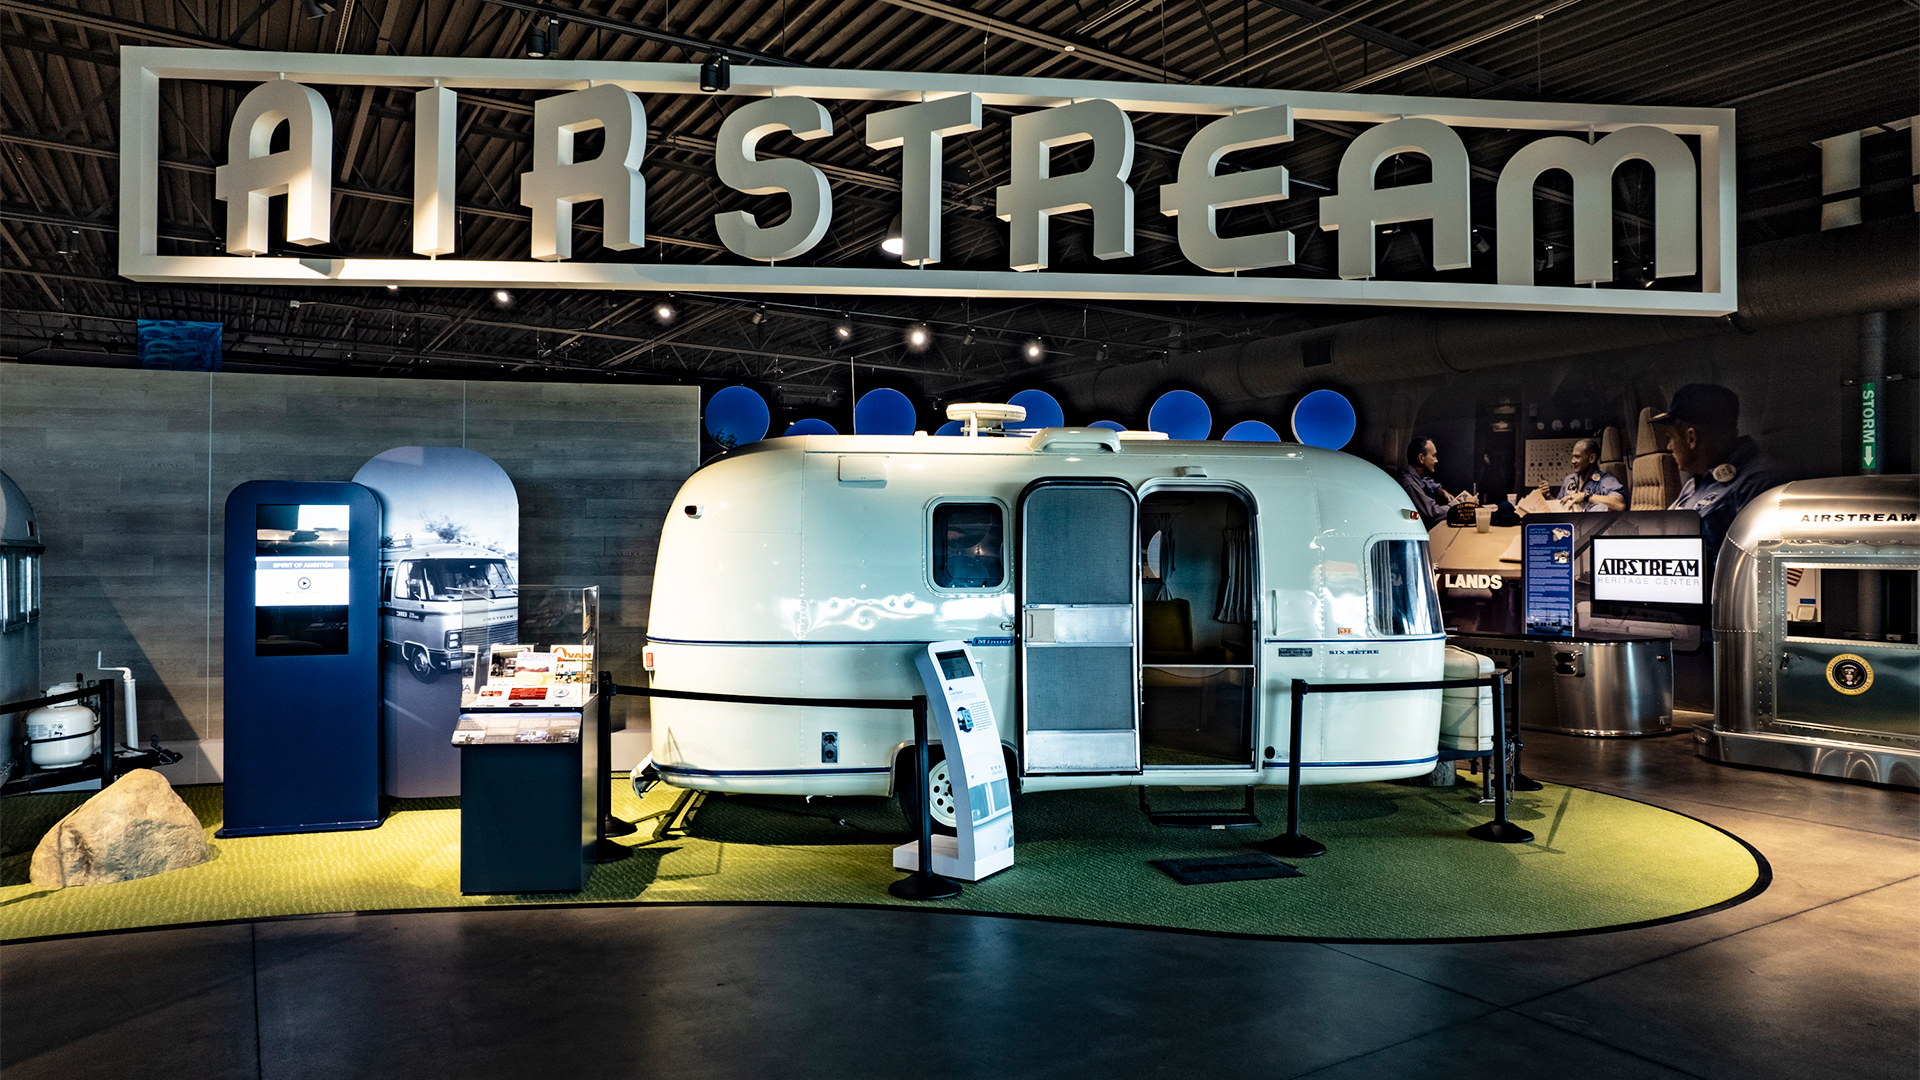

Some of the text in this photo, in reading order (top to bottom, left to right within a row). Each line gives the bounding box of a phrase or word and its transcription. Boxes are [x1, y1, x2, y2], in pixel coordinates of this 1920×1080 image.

[216, 80, 1698, 287] AIRSTREAM
[1862, 390, 1875, 443] STORM
[1800, 513, 1918, 522] AIRSTREAM
[1598, 558, 1699, 577] AIRSTREAM
[1445, 573, 1503, 590] LANDS
[1598, 576, 1700, 586] HERITAGE CENTER
